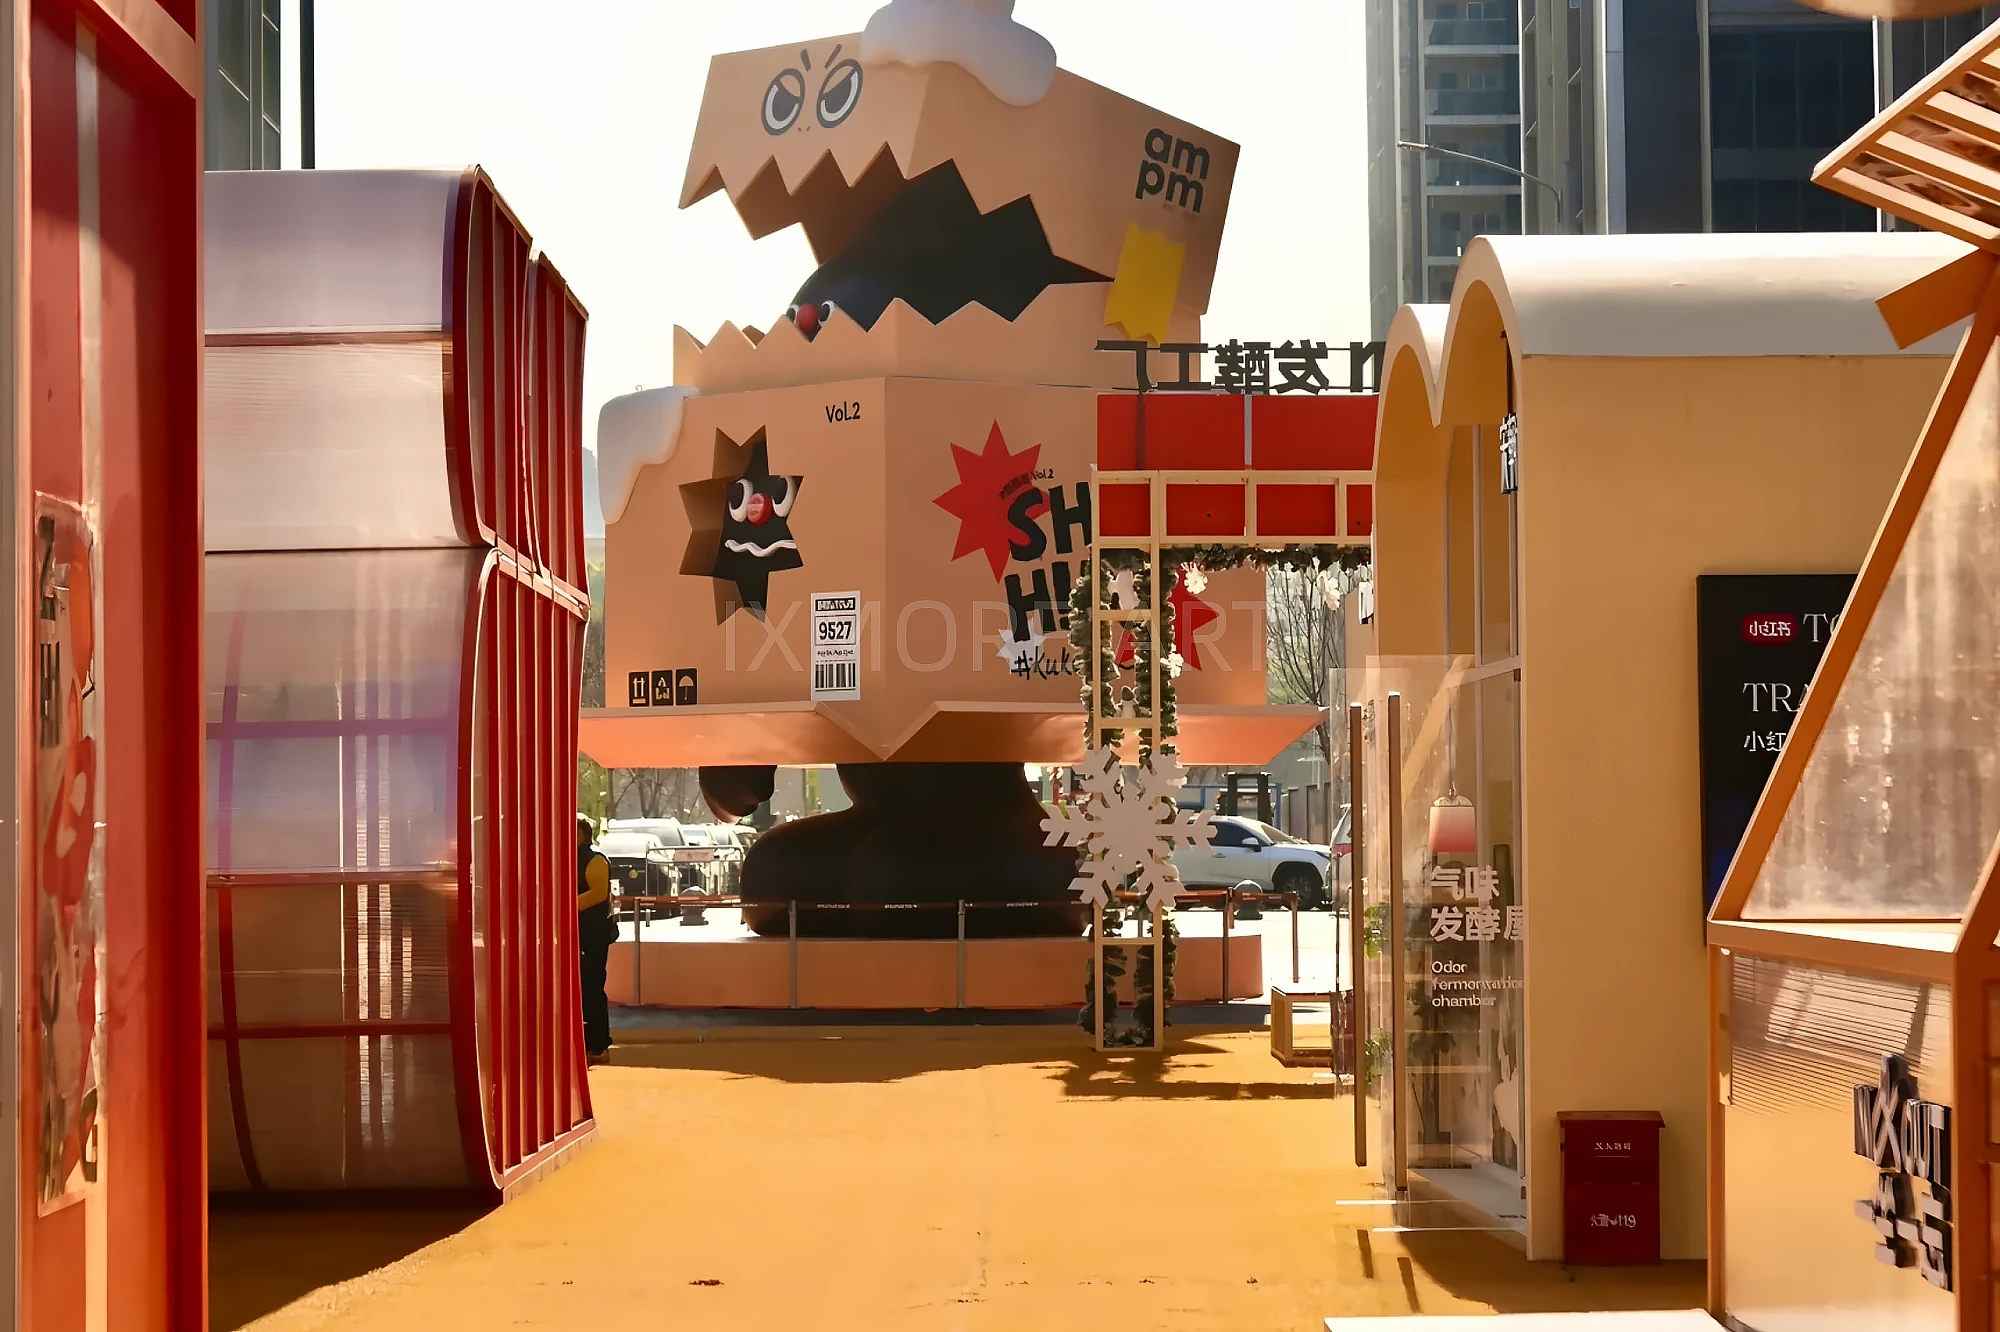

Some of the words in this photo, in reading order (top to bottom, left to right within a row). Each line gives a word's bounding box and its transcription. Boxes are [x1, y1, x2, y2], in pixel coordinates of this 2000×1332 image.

[1145, 128, 1210, 180] am
[1135, 159, 1204, 213] pm
[819, 620, 852, 640] 9527
[1431, 865, 1500, 901] 气味
[1431, 960, 1467, 973] Odor
